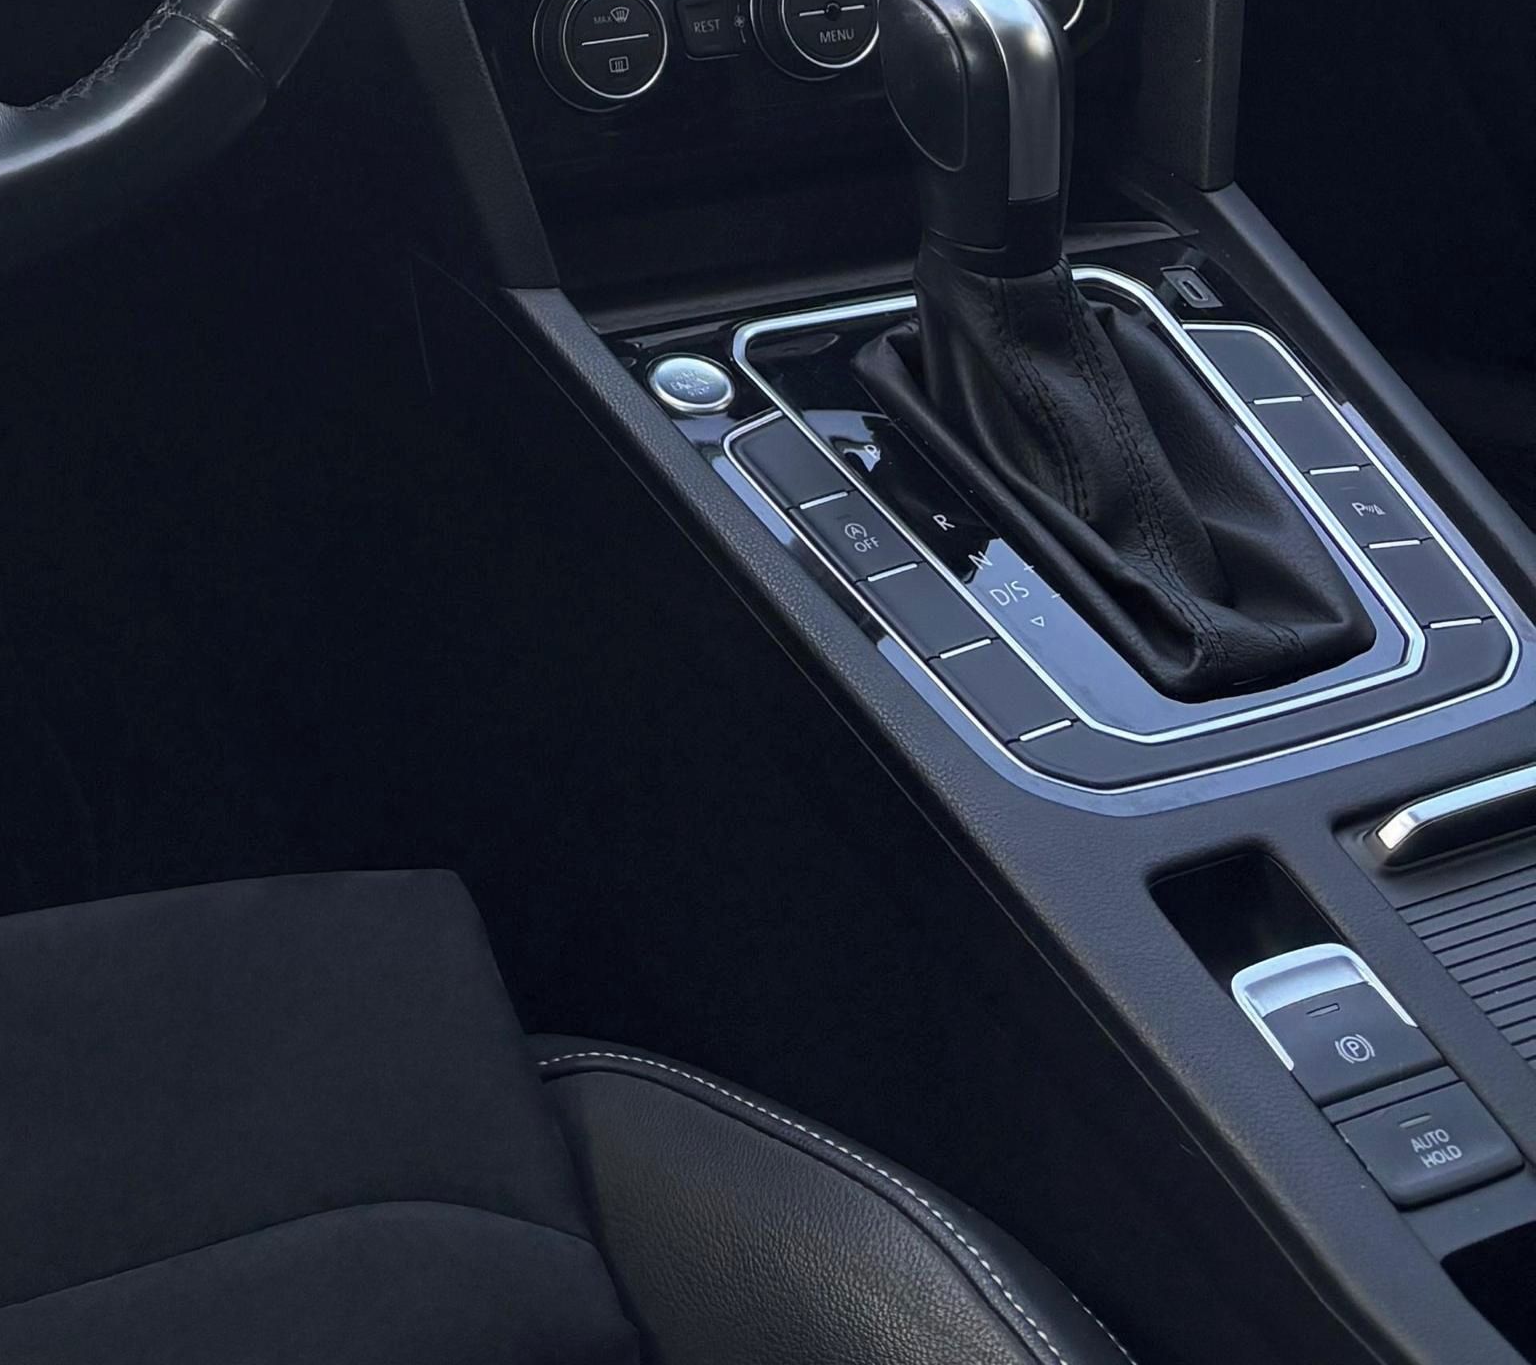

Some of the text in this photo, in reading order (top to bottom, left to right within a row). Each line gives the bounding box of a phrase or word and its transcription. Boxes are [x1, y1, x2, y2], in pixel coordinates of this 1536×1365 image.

[693, 18, 721, 33] REST
[819, 28, 855, 44] MENU
[864, 444, 880, 459] P
[933, 513, 956, 531] R
[854, 536, 881, 553] OFF
[967, 550, 994, 571] N
[989, 580, 1031, 607] D/S
[1410, 1128, 1451, 1154] AUTO
[1419, 1144, 1463, 1169] HOLD
